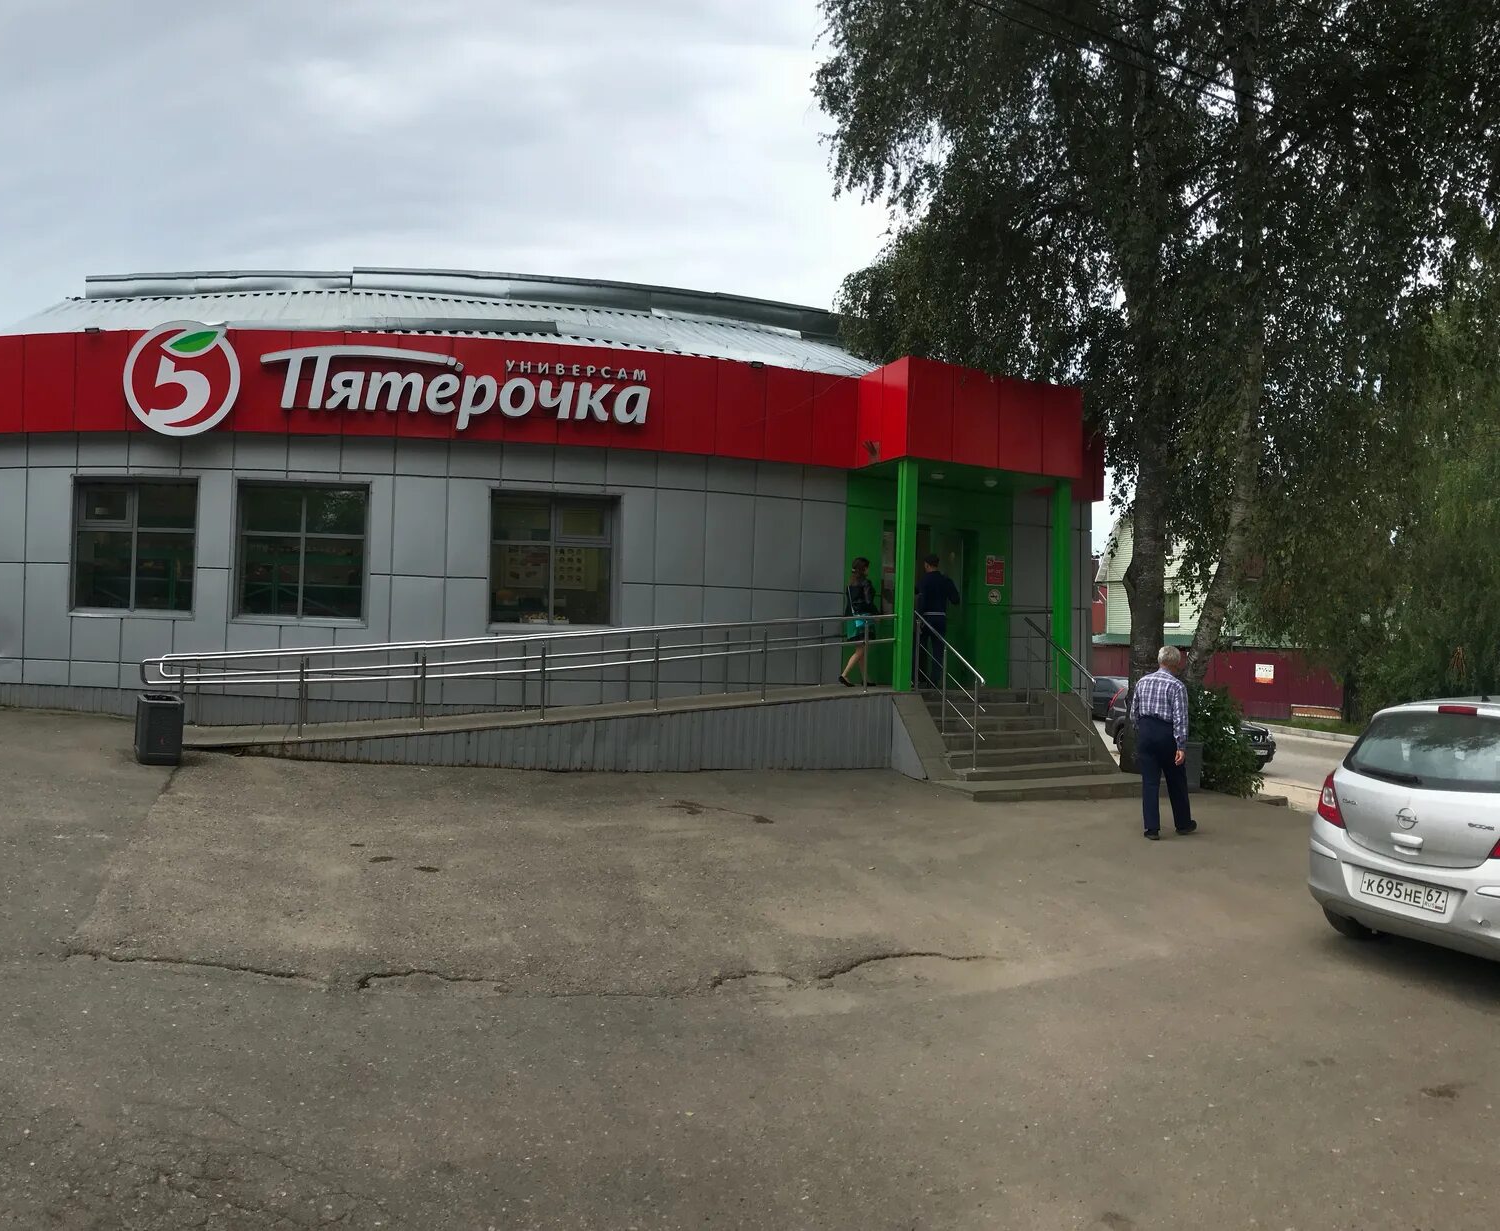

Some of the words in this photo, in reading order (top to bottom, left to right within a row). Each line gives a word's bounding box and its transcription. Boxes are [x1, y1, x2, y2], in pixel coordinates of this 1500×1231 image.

[505, 359, 647, 381] УНИВЕРСАМ
[145, 355, 211, 426] 5
[1367, 878, 1422, 905] К695НЕ
[1426, 888, 1442, 904] 67
